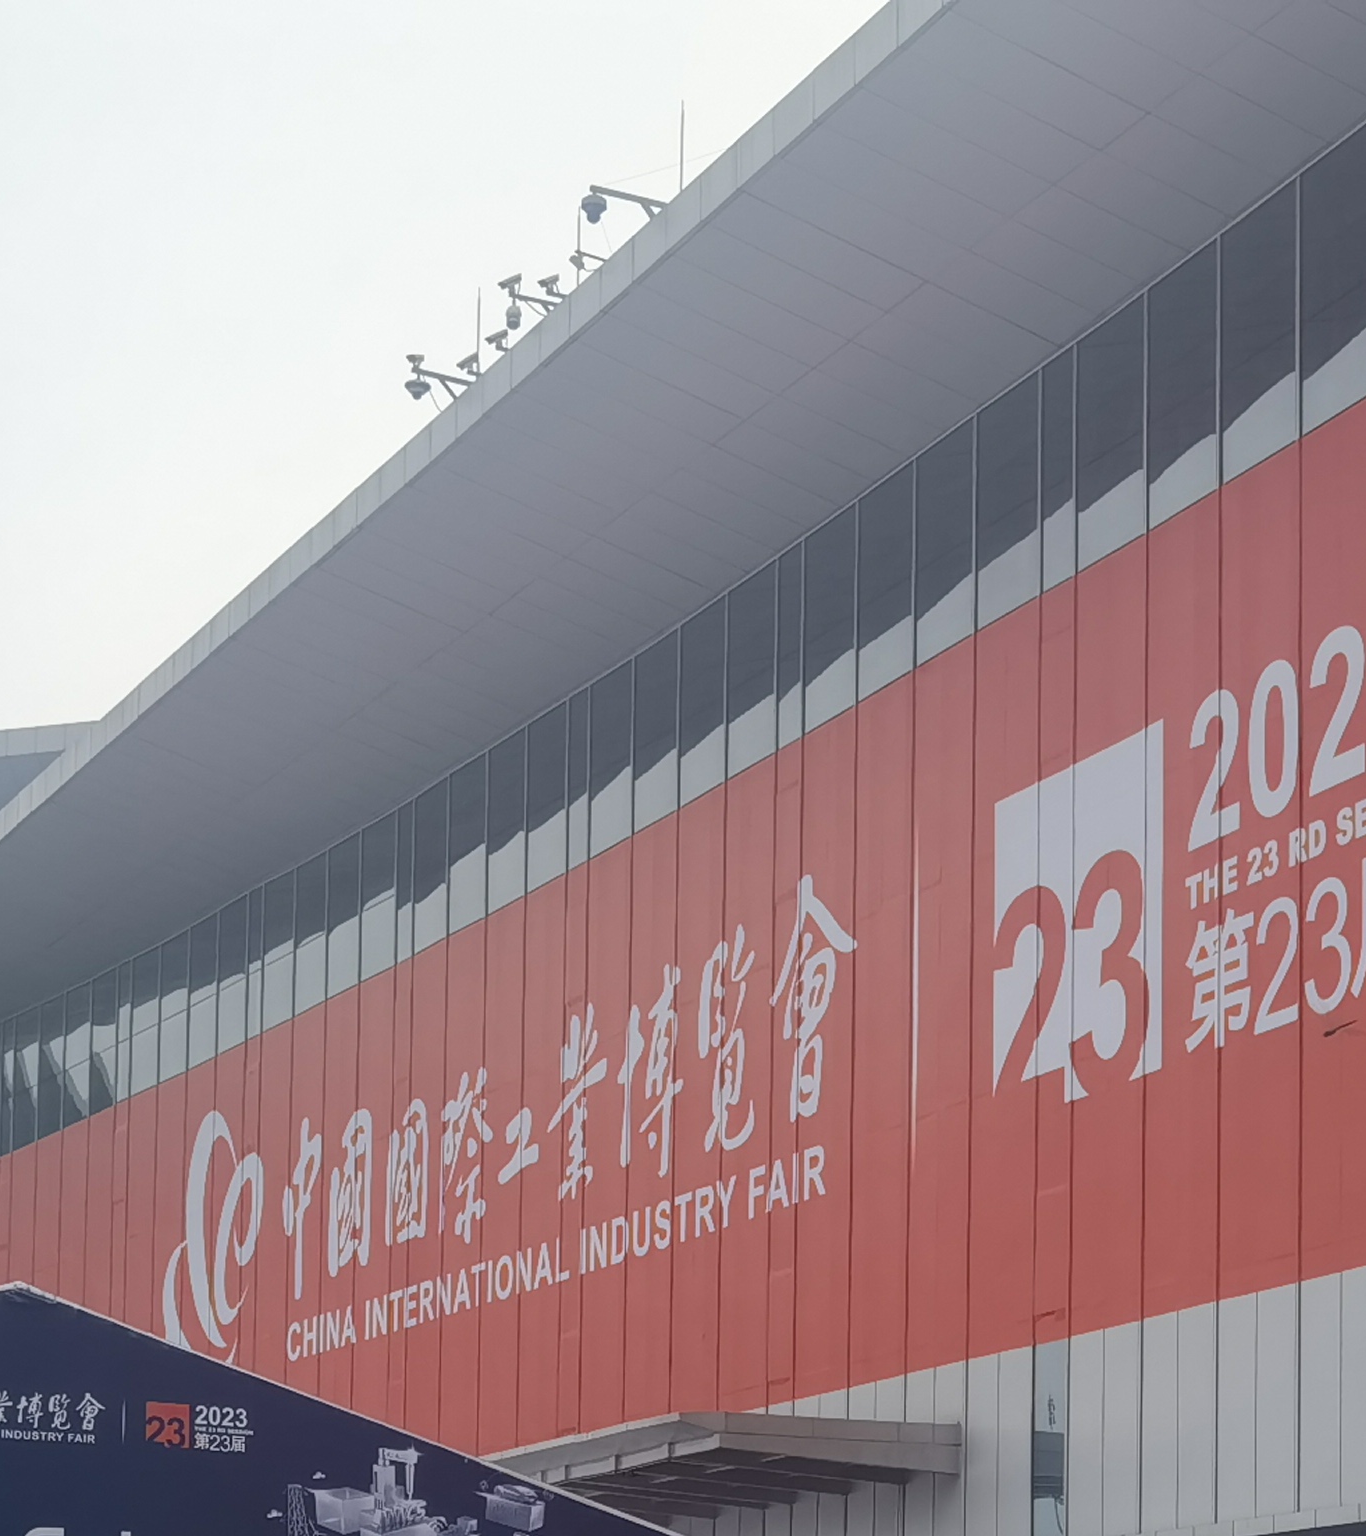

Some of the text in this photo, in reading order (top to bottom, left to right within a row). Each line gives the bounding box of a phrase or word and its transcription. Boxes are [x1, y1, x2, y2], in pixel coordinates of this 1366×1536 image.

[1184, 855, 1239, 911] THE
[1246, 839, 1280, 887] 23
[1288, 819, 1327, 868] RD
[286, 1144, 827, 1363] CHINA INTERNATIONAL INDUSTRY FAIR
[194, 1404, 248, 1428] 2023
[1, 1428, 65, 1443] INDUSTRY
[67, 1433, 96, 1445] FAIR
[193, 1432, 246, 1453] 第23届
